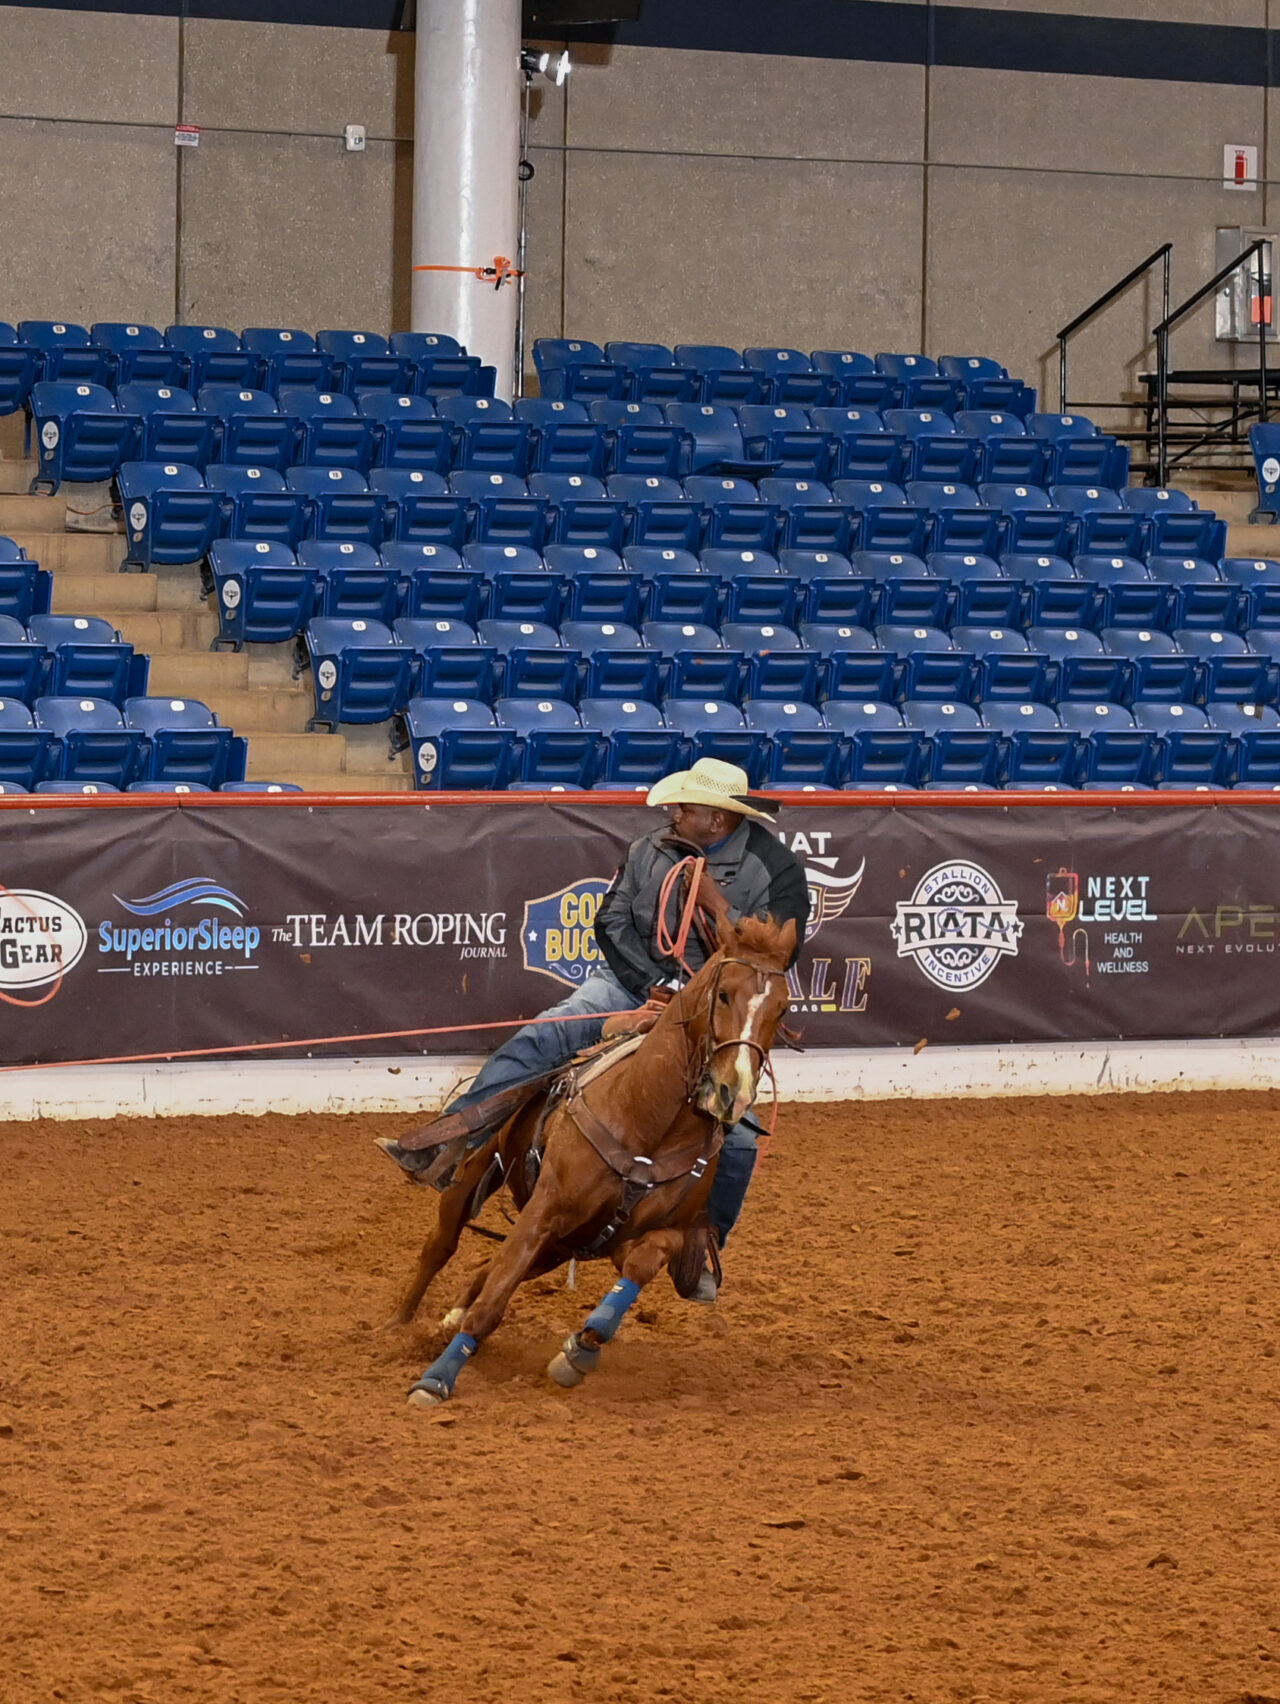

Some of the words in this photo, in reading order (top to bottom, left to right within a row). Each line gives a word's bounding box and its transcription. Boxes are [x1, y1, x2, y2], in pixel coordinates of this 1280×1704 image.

[924, 870, 990, 895] STALLION
[1088, 876, 1150, 898] NEXT
[1078, 899, 1158, 921] LEVEL
[99, 917, 260, 961] SuperiorSleep
[272, 928, 292, 942] The
[286, 914, 385, 947] TEAM
[390, 912, 507, 946] ROPING
[903, 911, 1010, 945] RIATA
[1104, 932, 1143, 944] HEALTH
[0, 939, 63, 969] GEAR
[460, 946, 508, 960] JOURNAL
[1113, 947, 1134, 958] AND
[1176, 944, 1215, 954] NEXT
[1225, 943, 1280, 953] EVOLU
[134, 961, 223, 976] EXPERIENCE
[924, 955, 991, 983] INCENTIVE
[1097, 961, 1149, 973] WELLNESS
